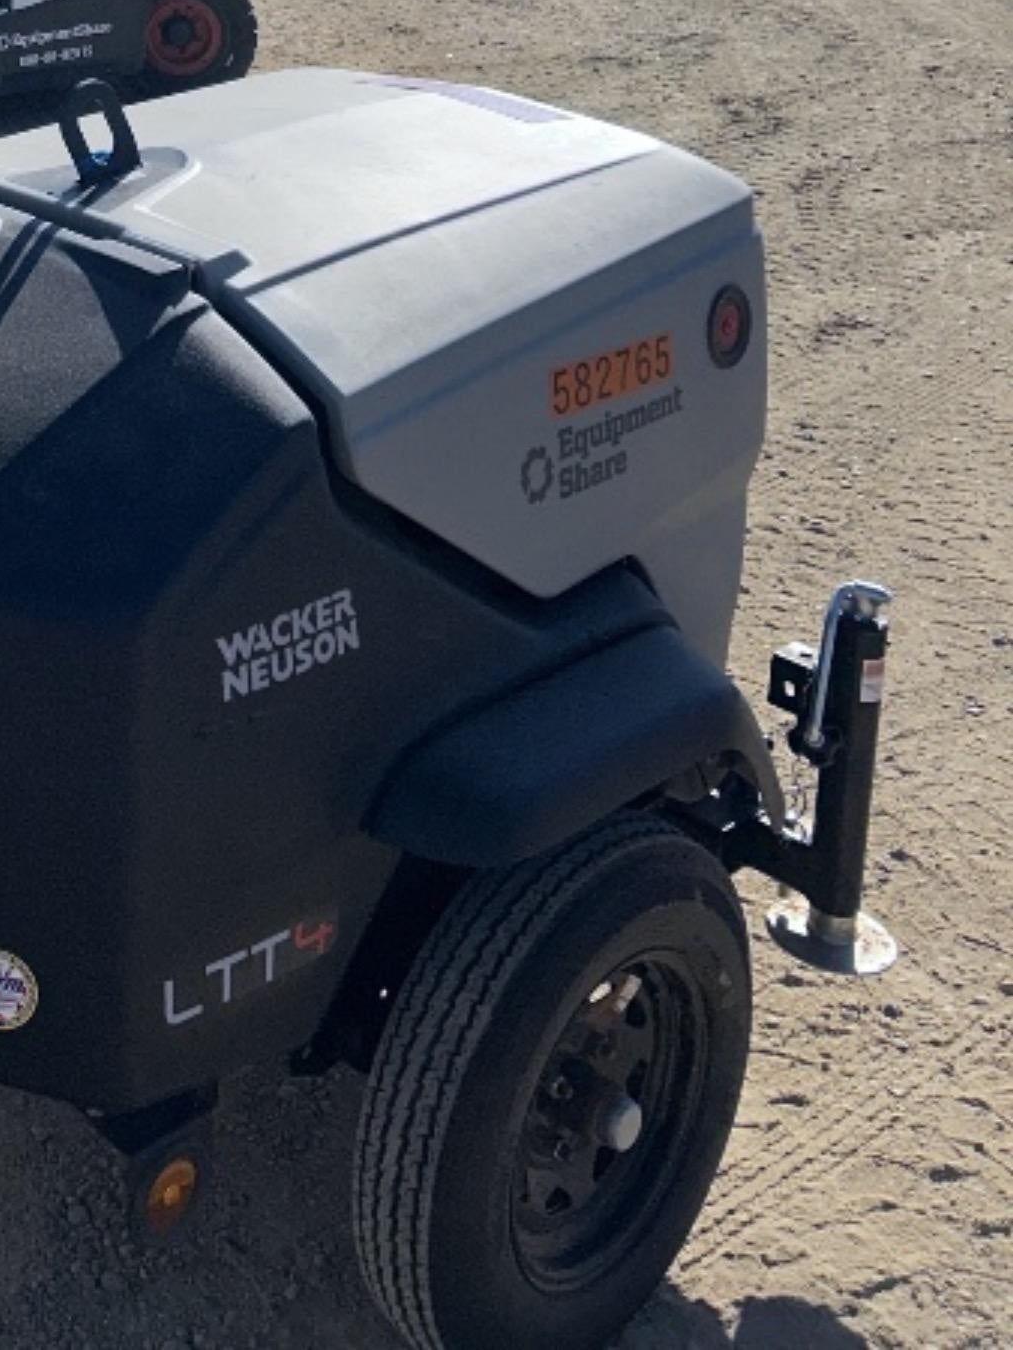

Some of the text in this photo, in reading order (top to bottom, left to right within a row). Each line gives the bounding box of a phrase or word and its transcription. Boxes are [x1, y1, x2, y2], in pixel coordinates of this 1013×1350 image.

[553, 336, 670, 414] 582765
[556, 386, 683, 460] Equipment
[559, 451, 628, 499] Share
[216, 588, 357, 666] WACKER
[222, 617, 360, 702] NEUSON
[163, 922, 333, 1024] LTT4
